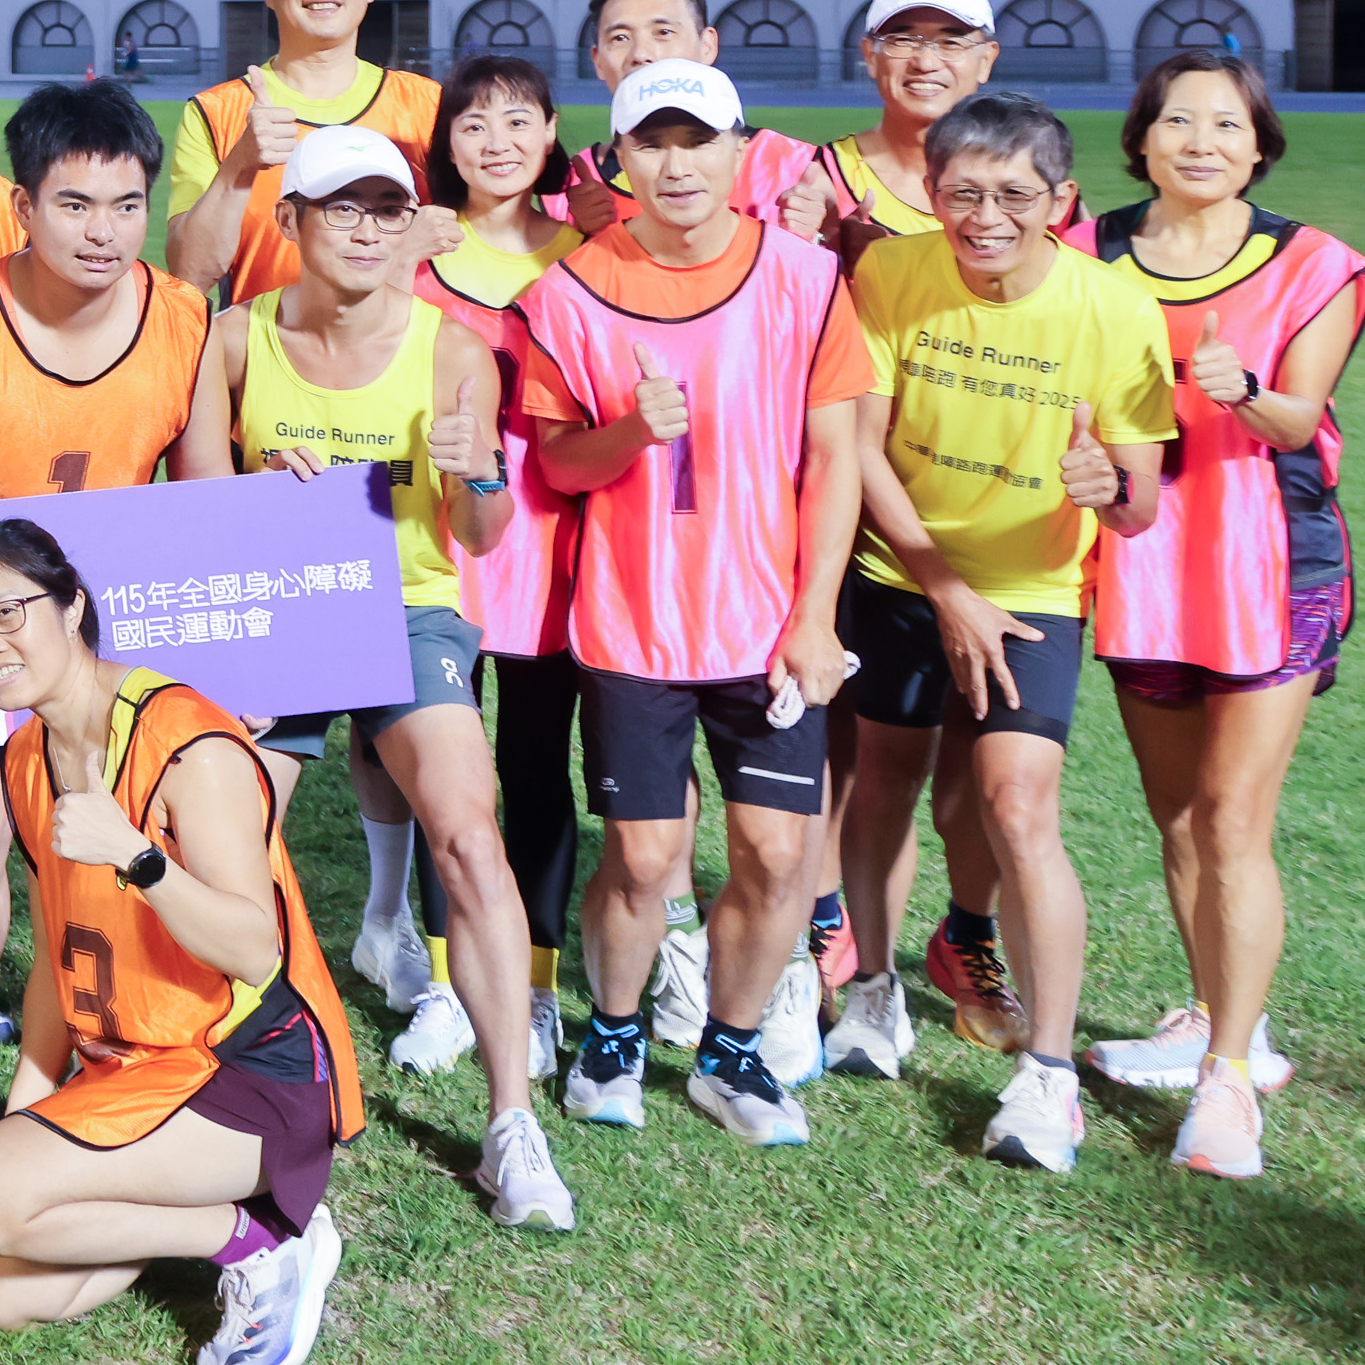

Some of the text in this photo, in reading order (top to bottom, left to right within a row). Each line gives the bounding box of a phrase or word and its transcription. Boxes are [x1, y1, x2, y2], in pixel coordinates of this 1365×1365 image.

[639, 78, 704, 101] HOKA
[917, 331, 1062, 374] Guide Runner
[275, 422, 395, 446] Guide Runner
[100, 559, 373, 616] 115年全國身心障礙
[111, 606, 274, 652] 國民運動會
[61, 921, 135, 1065] 3
